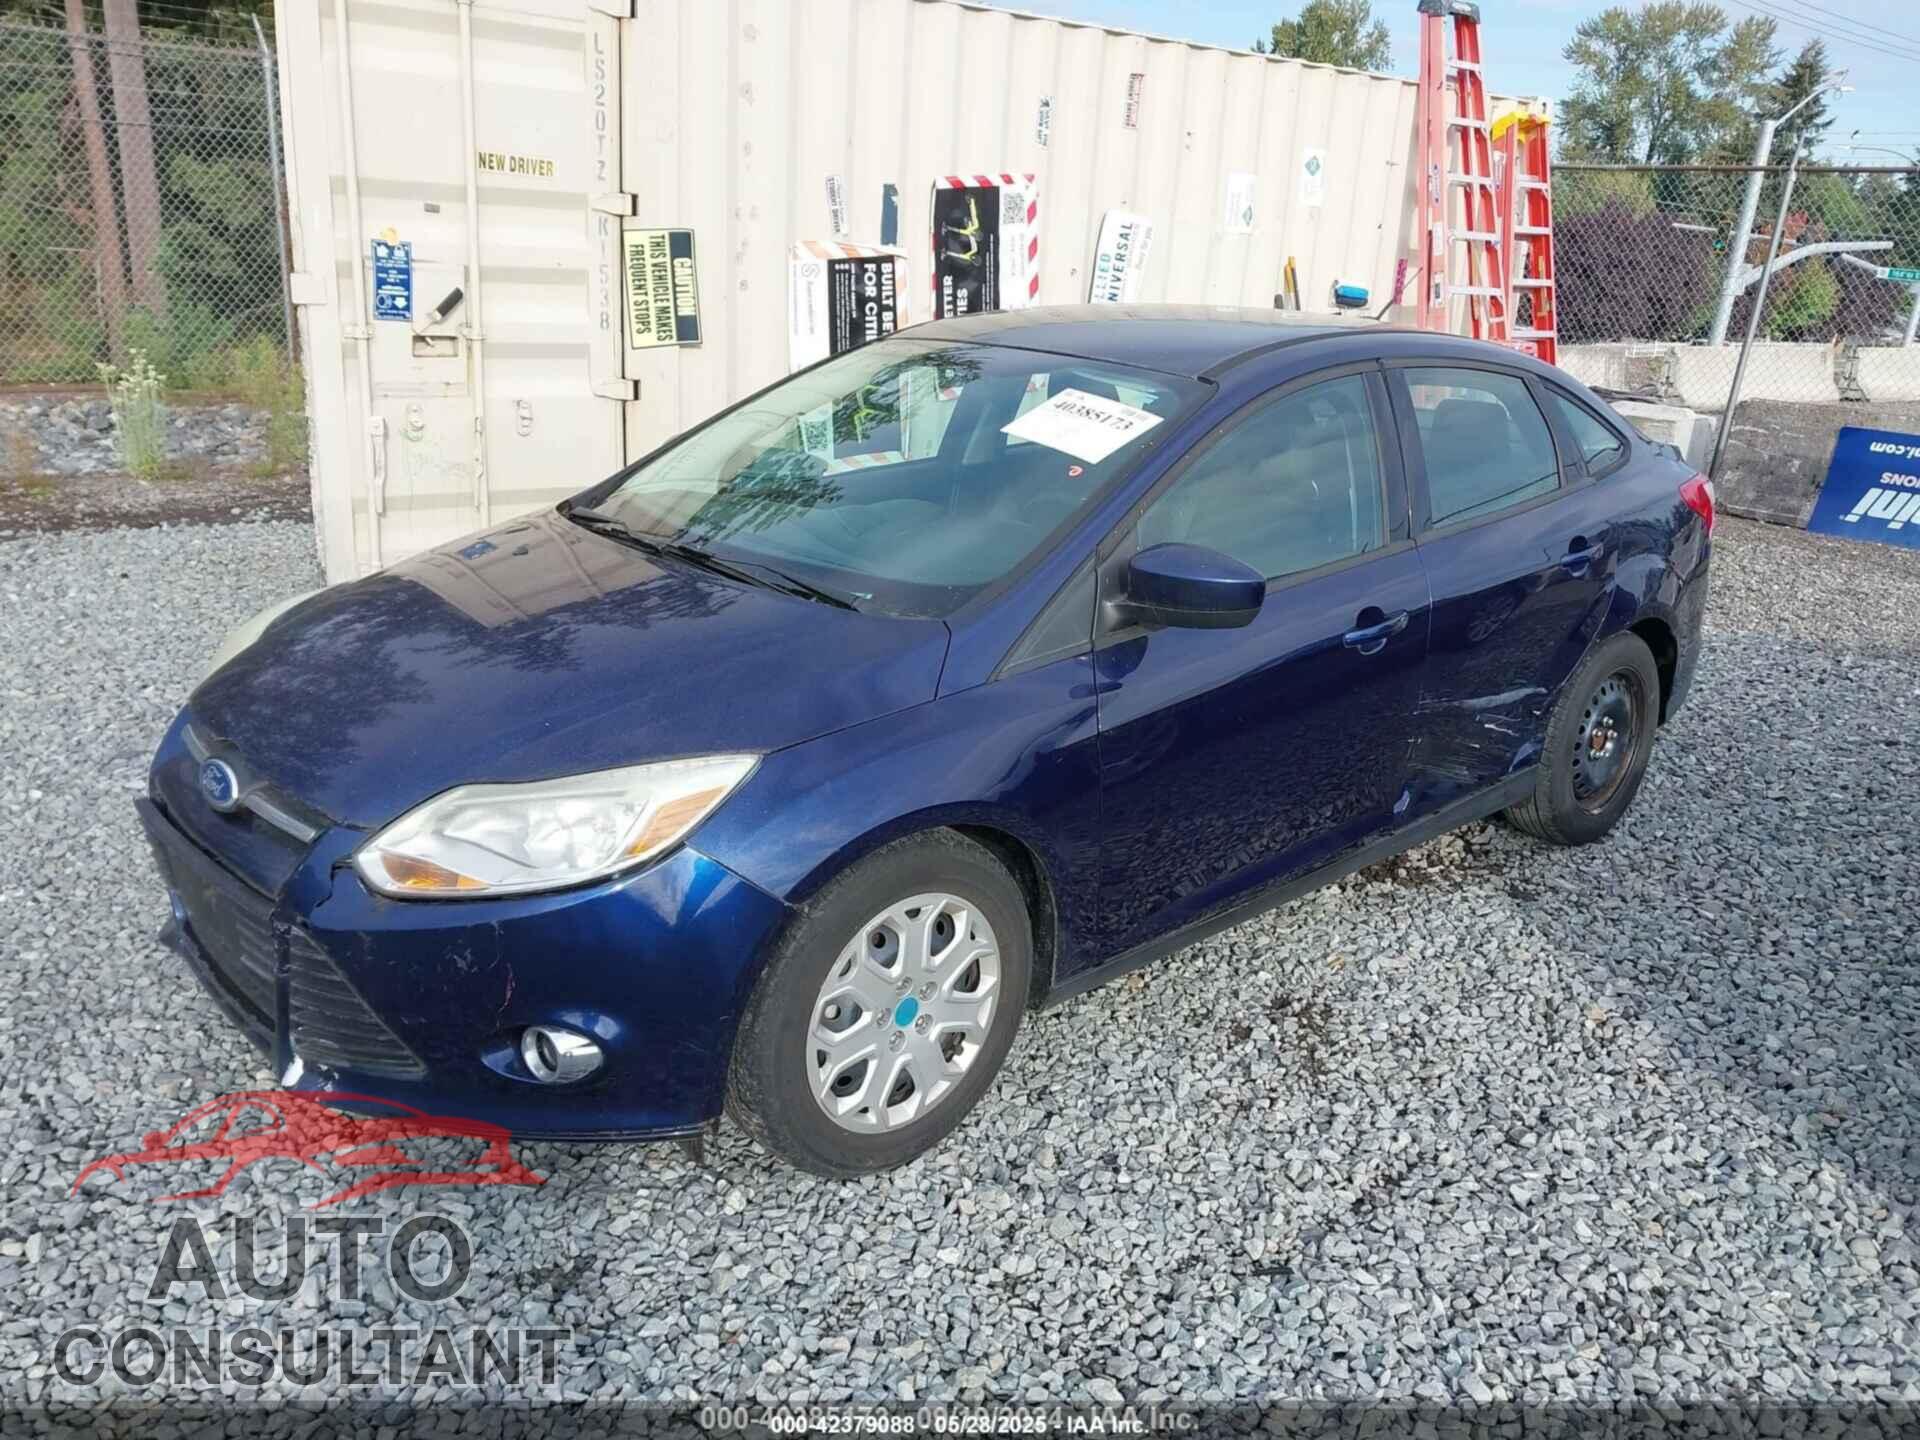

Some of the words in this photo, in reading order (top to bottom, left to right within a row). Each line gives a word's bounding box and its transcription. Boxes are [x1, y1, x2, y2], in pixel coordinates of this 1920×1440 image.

[478, 151, 506, 171] NEW
[509, 155, 553, 176] DRIVER
[831, 207, 841, 233] DRIVER
[649, 234, 668, 260] THIS
[1108, 223, 1133, 302] NIVERSAL
[629, 244, 649, 297] FREQUENT
[650, 260, 671, 304] VEHICLE
[673, 257, 696, 316] CAUTION
[864, 263, 877, 298] FOR
[881, 262, 894, 307] BUILT
[943, 275, 954, 318] ETTER
[633, 299, 652, 335] STOPS
[655, 306, 674, 341] MAKES
[1054, 401, 1134, 431] 40385173
